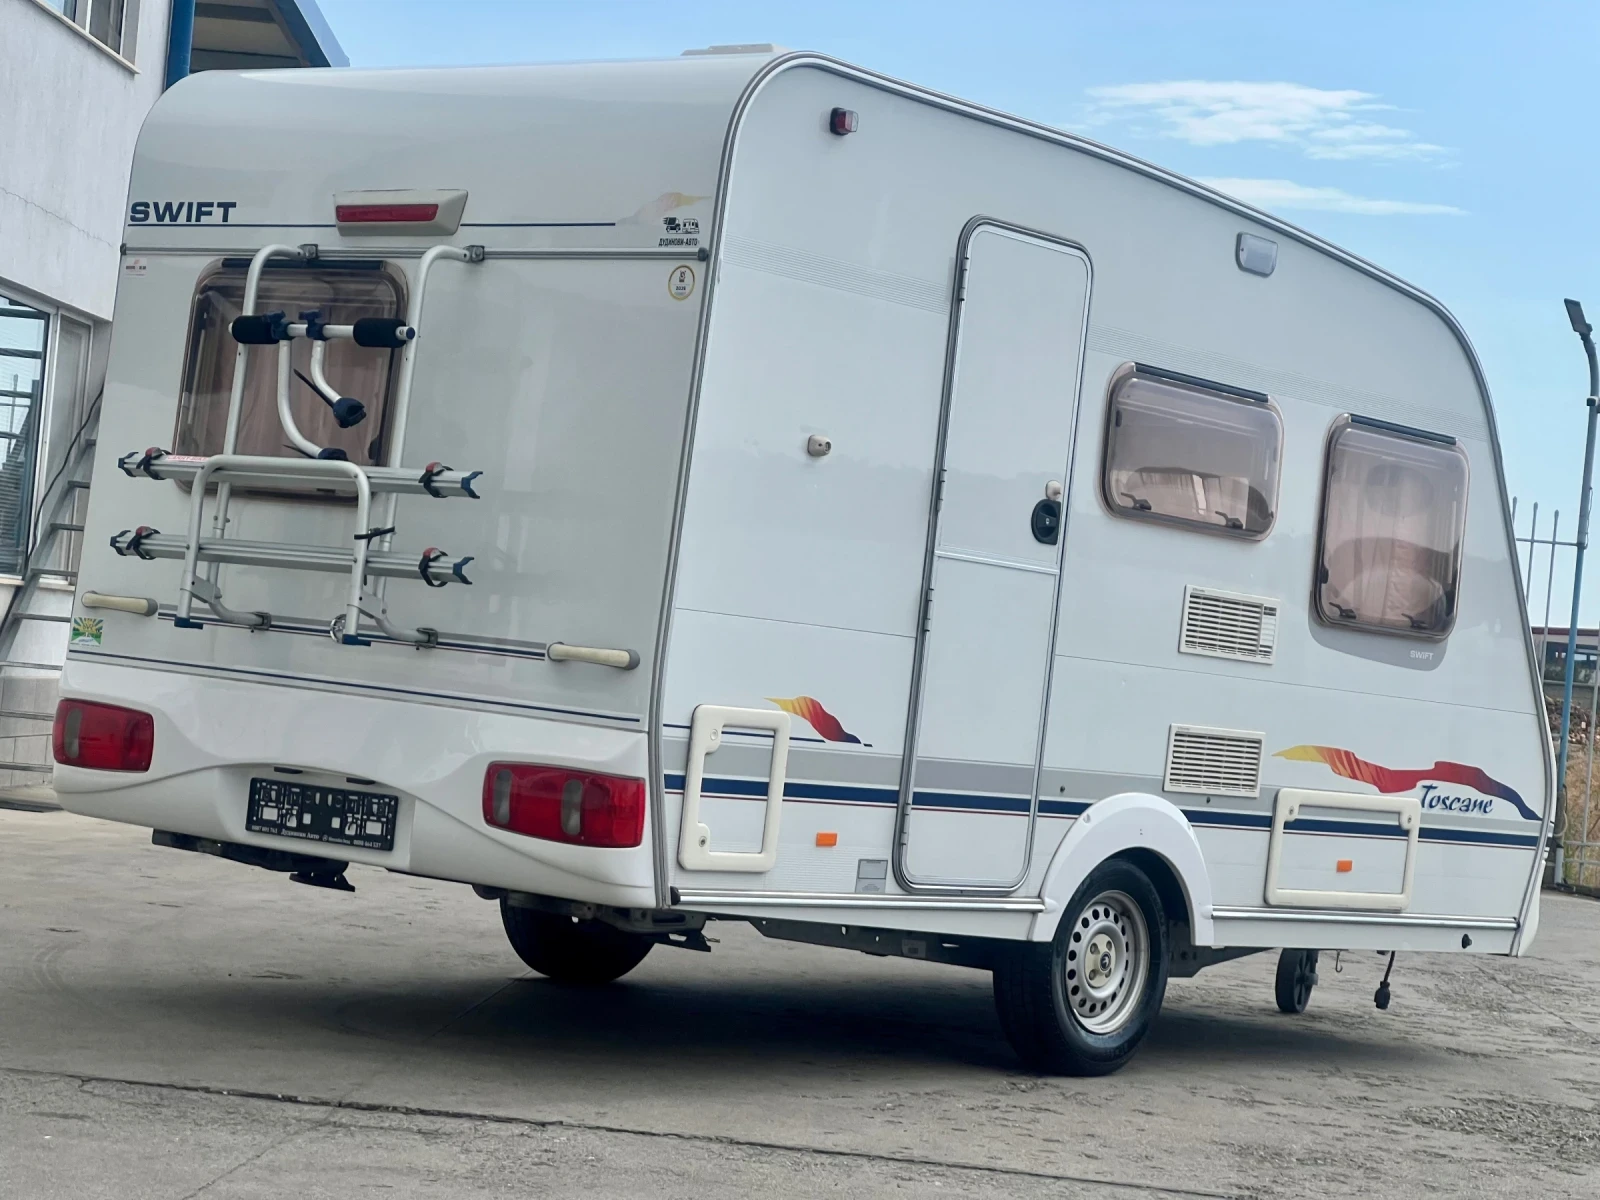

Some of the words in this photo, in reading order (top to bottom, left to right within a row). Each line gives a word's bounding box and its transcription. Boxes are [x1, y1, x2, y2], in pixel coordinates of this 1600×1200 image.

[130, 201, 237, 223] SWIFT
[1410, 650, 1434, 660] SWIFT
[1421, 783, 1494, 813] Toscane
